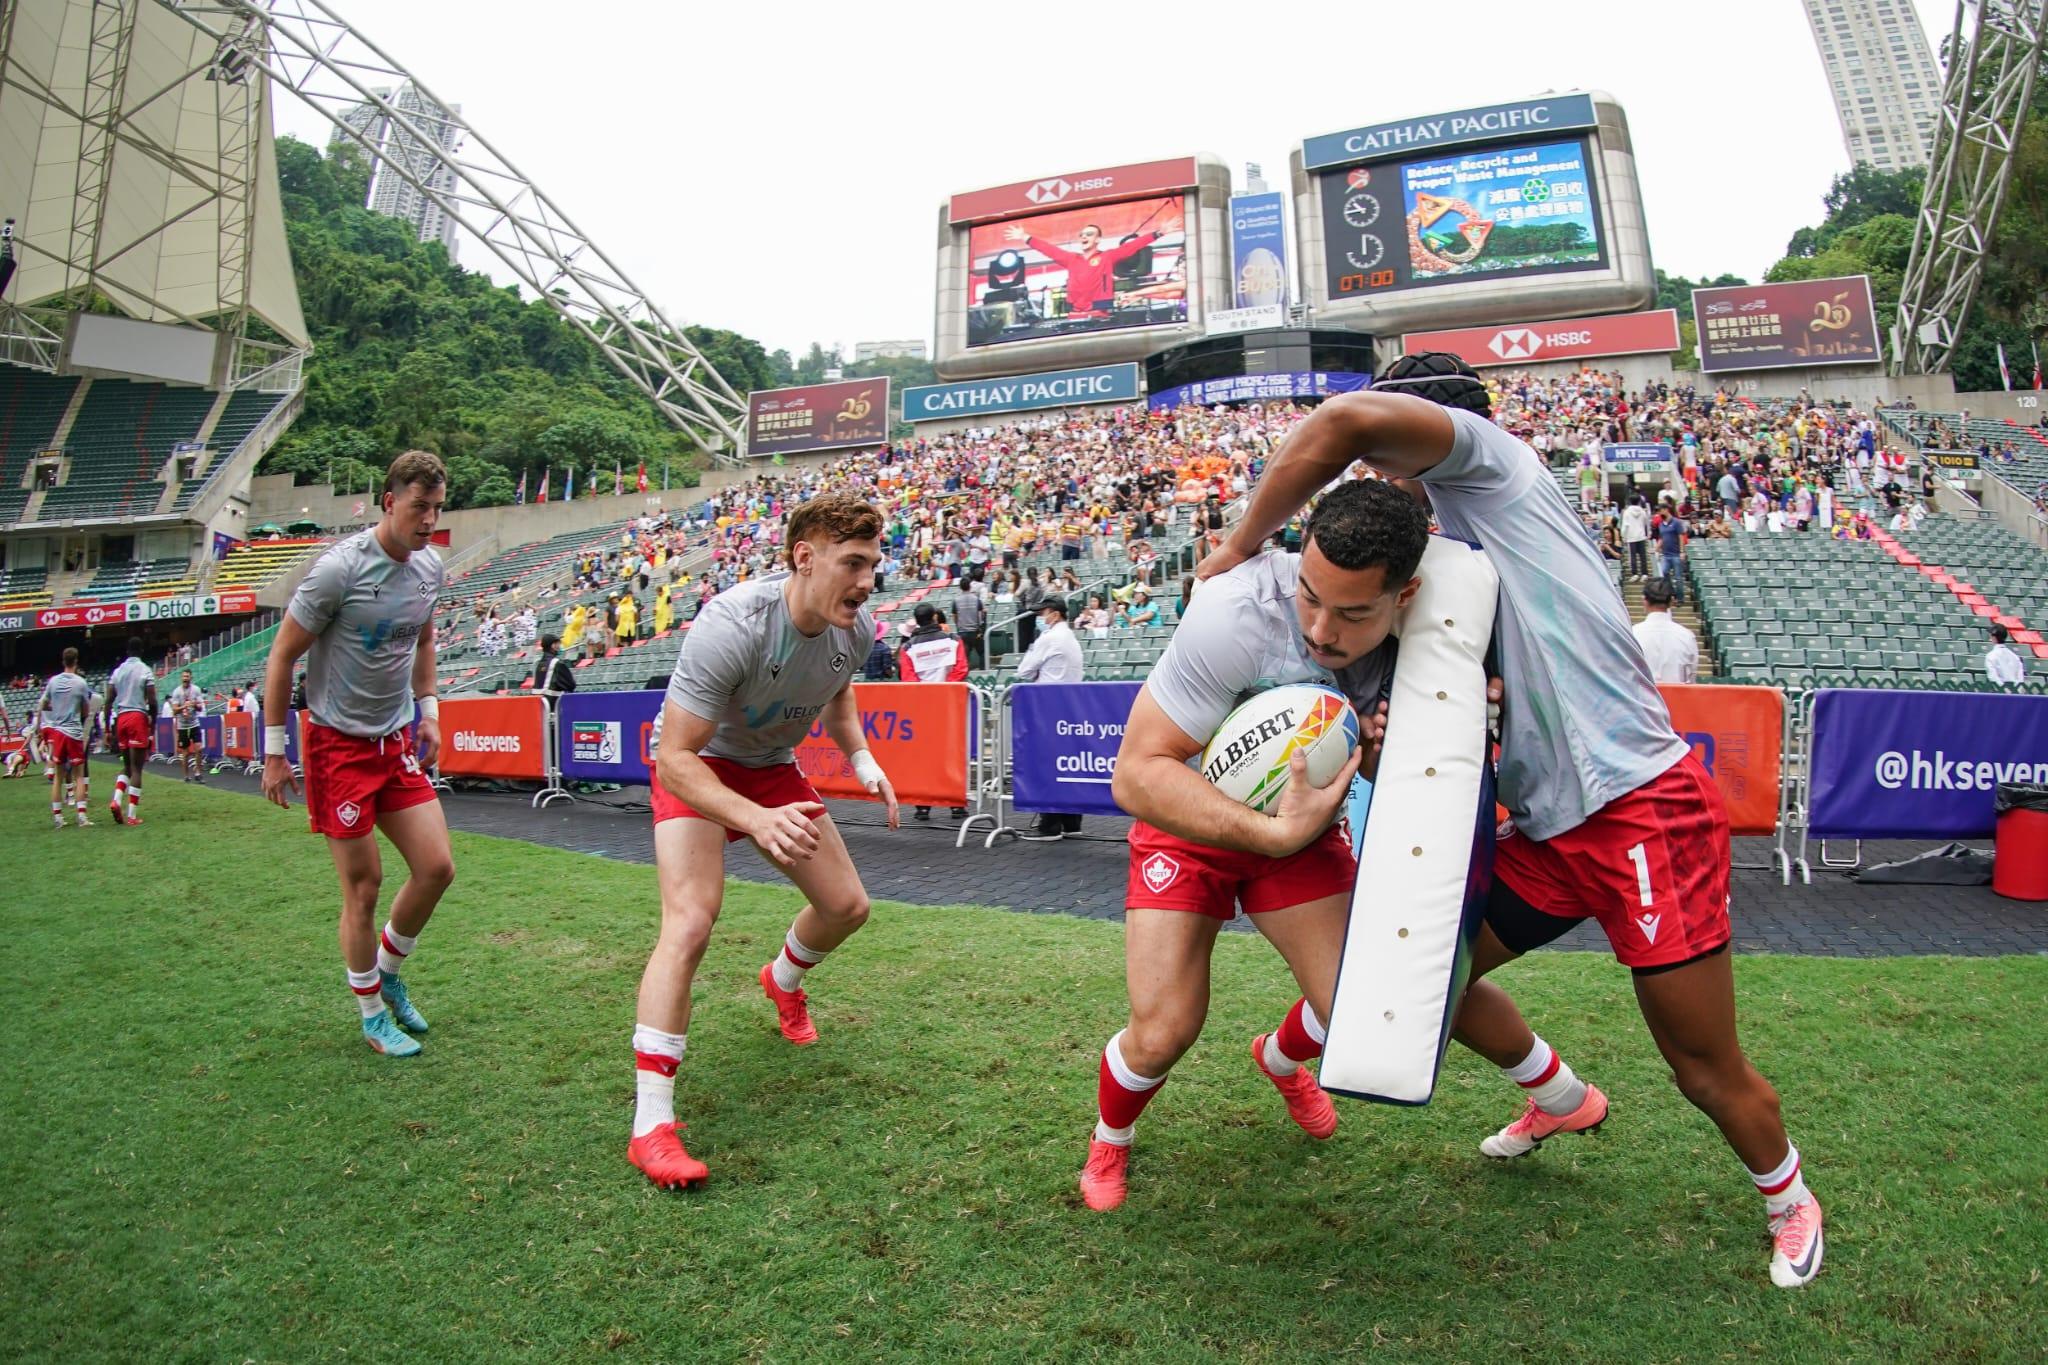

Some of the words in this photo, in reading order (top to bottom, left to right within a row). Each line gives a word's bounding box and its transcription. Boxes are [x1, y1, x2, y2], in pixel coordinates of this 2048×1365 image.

[1344, 120, 1445, 152] CATHAY
[1451, 106, 1550, 135] PACIFIC
[1407, 166, 1457, 179] Reduce,
[1461, 155, 1510, 172] Recycle
[1512, 152, 1538, 164] and
[1408, 176, 1452, 190] Proper
[1454, 169, 1494, 183] Waste
[1496, 160, 1581, 178] Management
[1074, 177, 1113, 192] HSBC
[1551, 181, 1584, 197] 回收
[1339, 269, 1395, 292] 07:00
[1212, 310, 1243, 321] SOUTH
[1246, 306, 1276, 317] STAND
[1546, 331, 1592, 347] HSBC
[924, 385, 1018, 411] CATHAY
[1022, 374, 1113, 400] PACIFIC
[1256, 385, 1293, 398] SEVENS
[2016, 397, 2038, 408] 120
[1615, 449, 1637, 458] HKT
[149, 598, 195, 619] Dettol
[858, 711, 913, 740] K7s
[1056, 720, 1095, 736] Grab
[453, 731, 521, 753] @hksevens
[1627, 842, 1653, 907] 1
